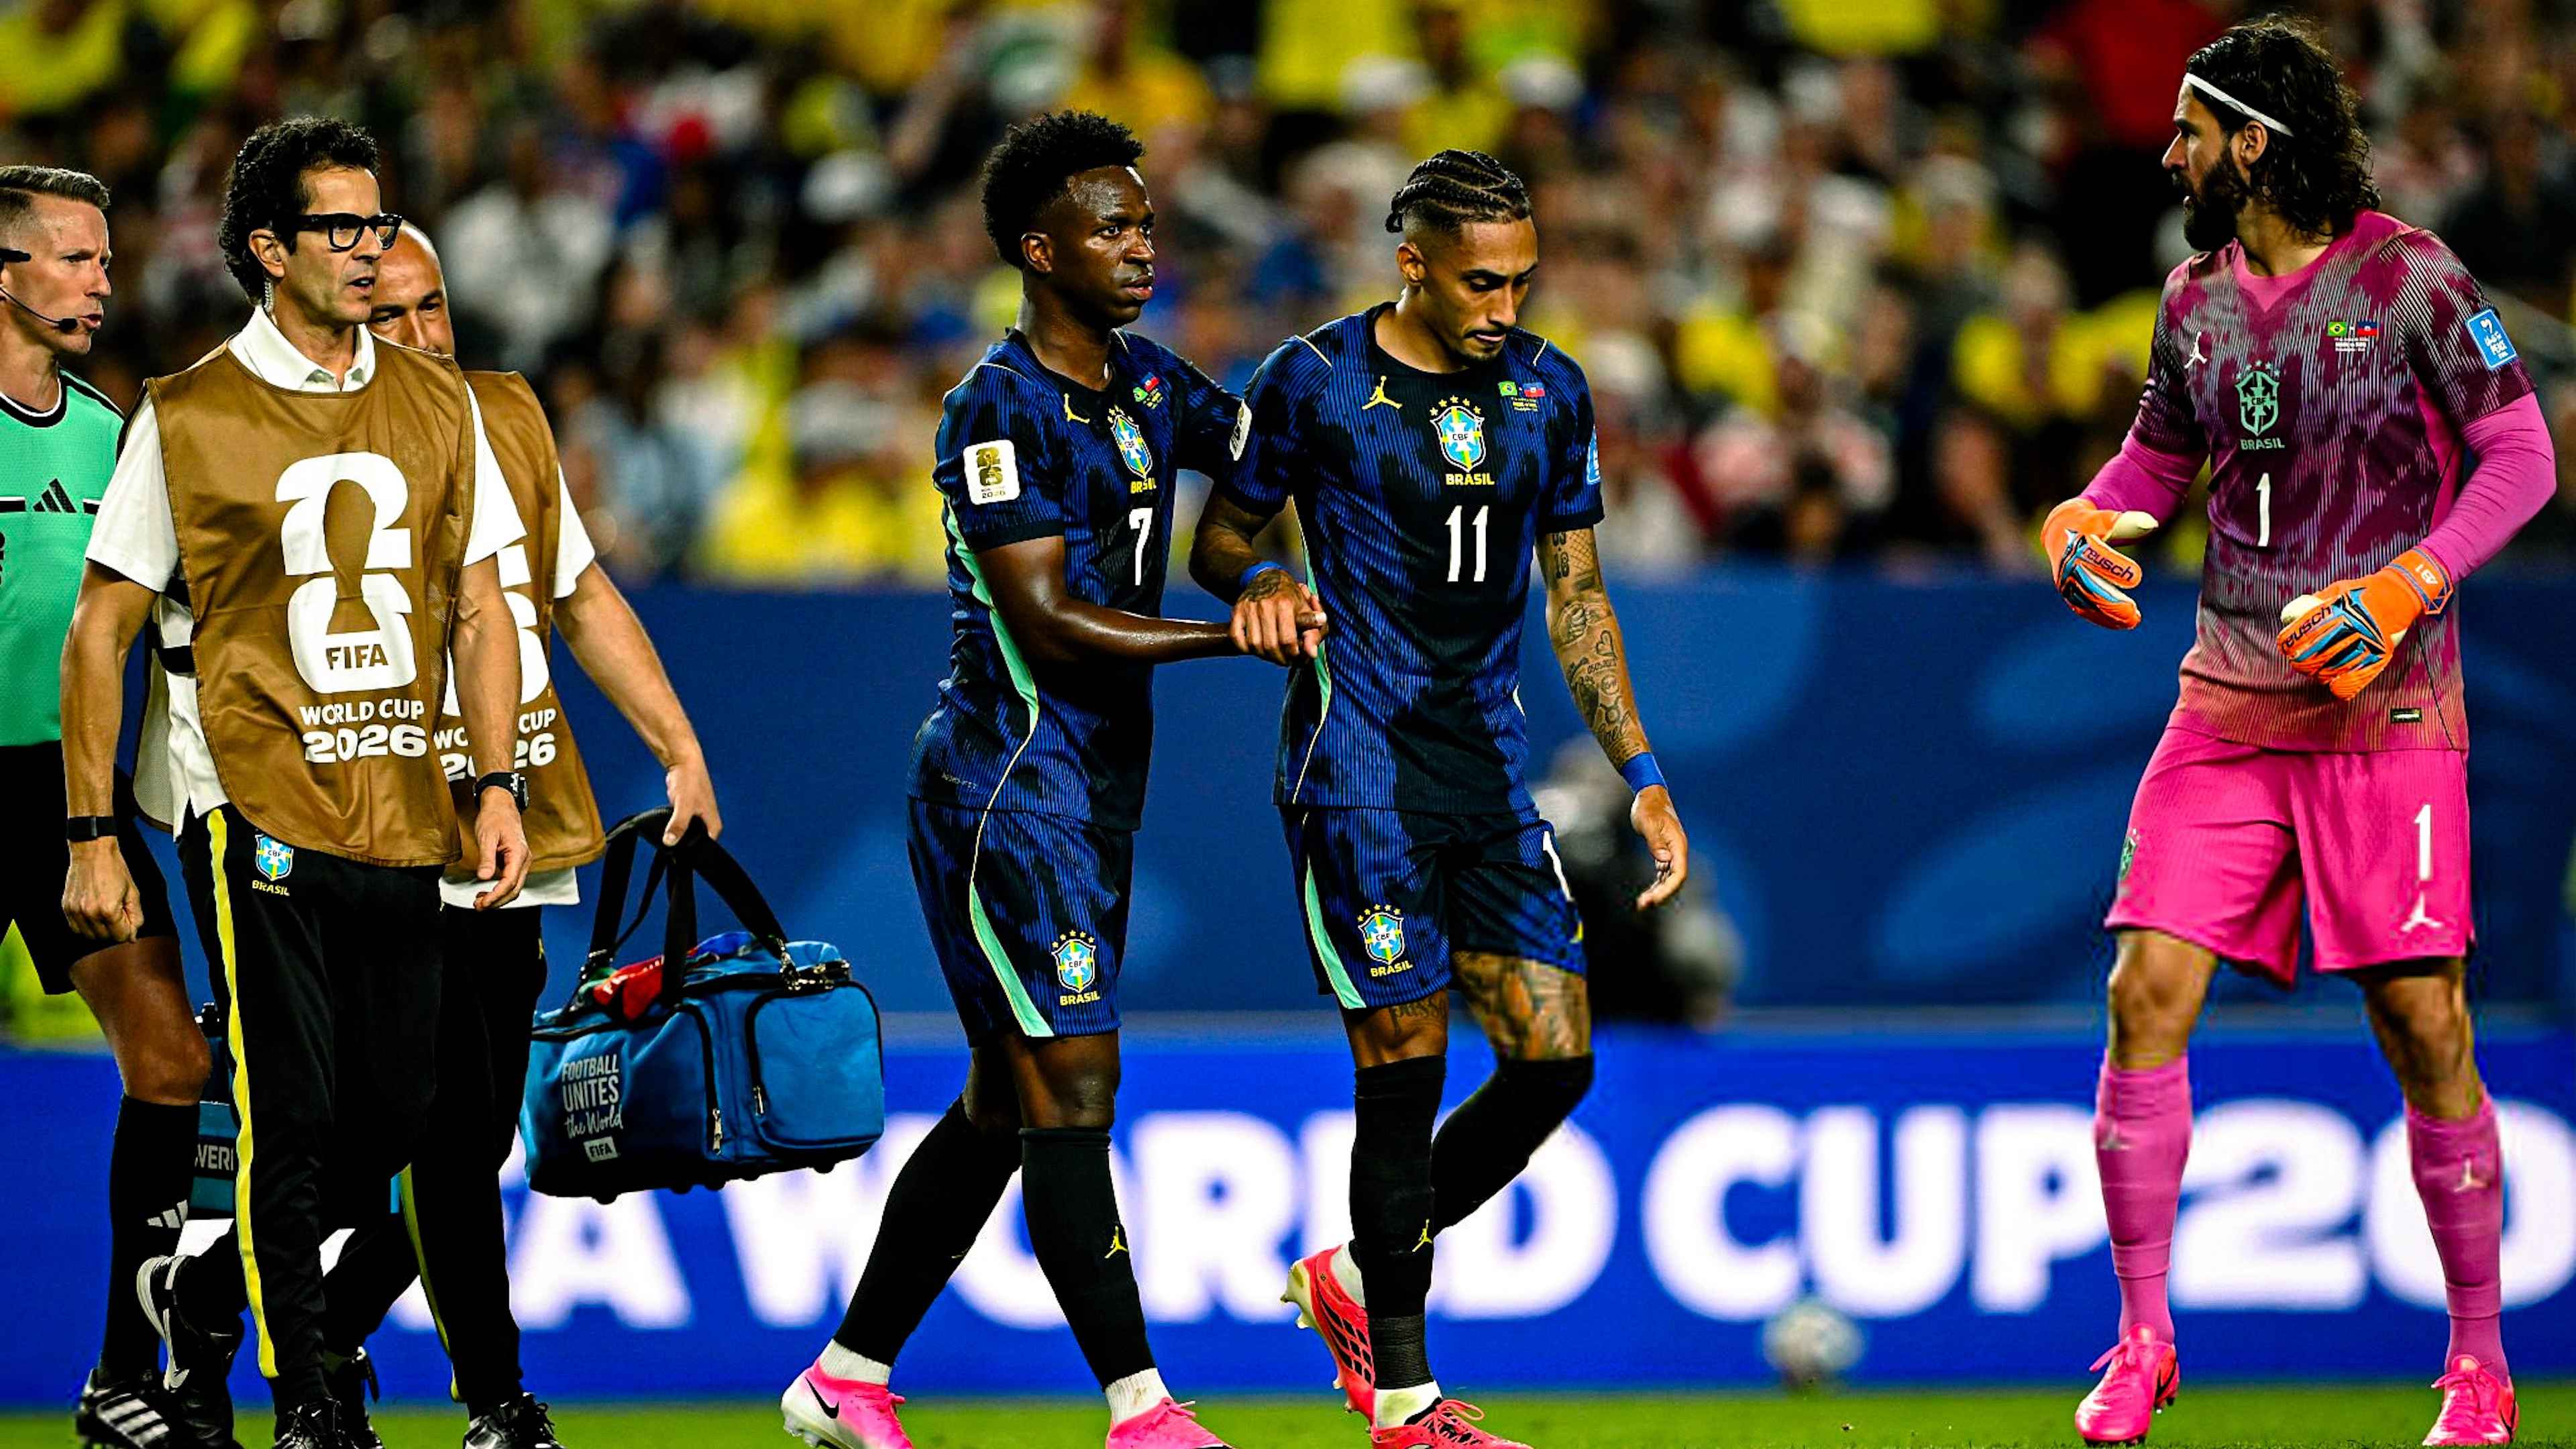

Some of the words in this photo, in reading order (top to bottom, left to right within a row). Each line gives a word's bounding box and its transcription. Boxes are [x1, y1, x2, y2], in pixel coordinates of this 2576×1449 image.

[2251, 397, 2267, 406] CBF
[1452, 433, 1469, 441] CBF
[2241, 437, 2286, 450] BRASIL
[1445, 472, 1495, 486] BRASIL
[2255, 472, 2271, 547] 1
[1129, 507, 1153, 586] 7
[1444, 505, 1489, 582] 11
[2082, 547, 2135, 582] reusch
[2279, 605, 2332, 656] reusch
[325, 644, 389, 669] FIFA
[299, 701, 375, 727] WORLD
[378, 698, 425, 720] CUP
[518, 708, 556, 734] CUP
[302, 724, 427, 763] 2026
[2414, 804, 2431, 881] 1
[252, 879, 290, 896] BRASIL
[1371, 960, 1413, 977] BRASIL
[1060, 991, 1100, 1006] BRASIL
[561, 1054, 619, 1082] FOOTBALL
[562, 1075, 619, 1112] UNITES
[564, 1114, 586, 1139] the
[586, 1104, 624, 1134] World
[589, 1143, 612, 1157] FIFA
[1641, 1102, 2113, 1322] CUP
